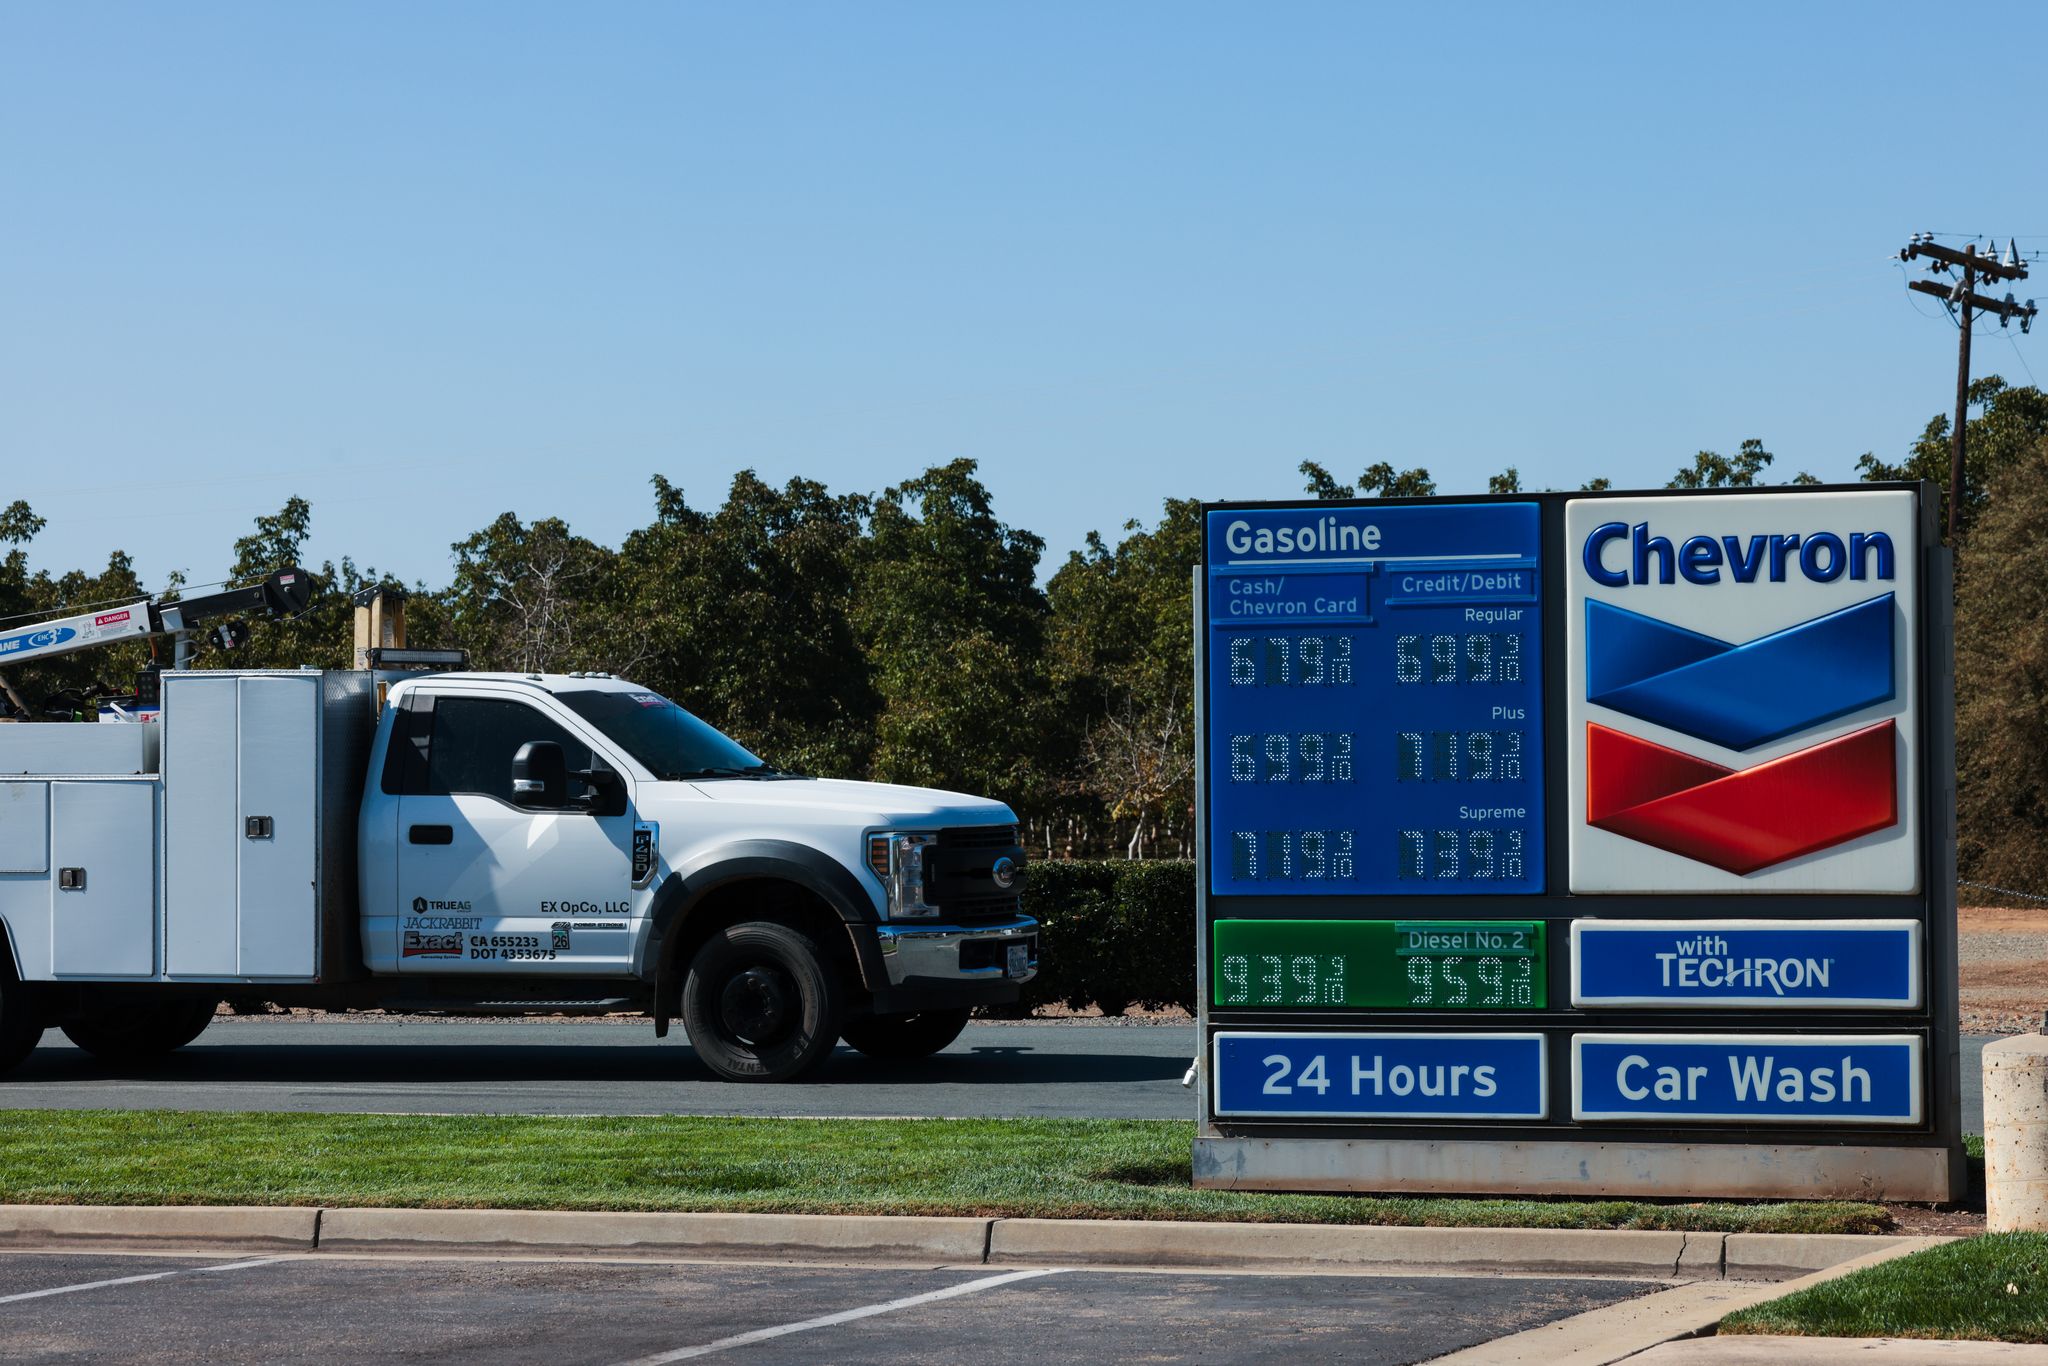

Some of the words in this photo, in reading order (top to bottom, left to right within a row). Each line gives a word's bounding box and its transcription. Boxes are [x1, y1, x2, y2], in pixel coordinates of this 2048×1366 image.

[1226, 516, 1381, 554] Gasoline
[1582, 521, 1896, 588] Chevron
[1230, 576, 1285, 595] Cash/
[1402, 572, 1521, 593] Credit/Debit
[1230, 599, 1306, 615] Chevron
[1314, 597, 1357, 613] Card
[104, 613, 128, 623] DANGER
[1465, 608, 1523, 624] Regular
[0, 640, 20, 653] NE
[1492, 706, 1526, 720] Plus
[1459, 806, 1526, 821] Supreme
[541, 901, 558, 912] EX
[561, 901, 602, 914] OpCo,
[605, 901, 630, 912] LLC
[403, 917, 483, 930] JACKRABBIT
[404, 931, 464, 950] Exact
[471, 936, 488, 947] CA
[491, 936, 539, 947] 655233
[553, 935, 568, 948] 26
[1409, 931, 1468, 949] Diesel
[1476, 931, 1507, 949] No.
[1512, 931, 1525, 949] 2
[1676, 935, 1728, 956] with
[471, 949, 498, 959] DOT
[501, 949, 556, 960] 4353675
[1261, 1054, 1331, 1095] 24
[1351, 1055, 1498, 1097] Hours
[1616, 1055, 1708, 1101] Car
[1728, 1055, 1872, 1103] Wash
